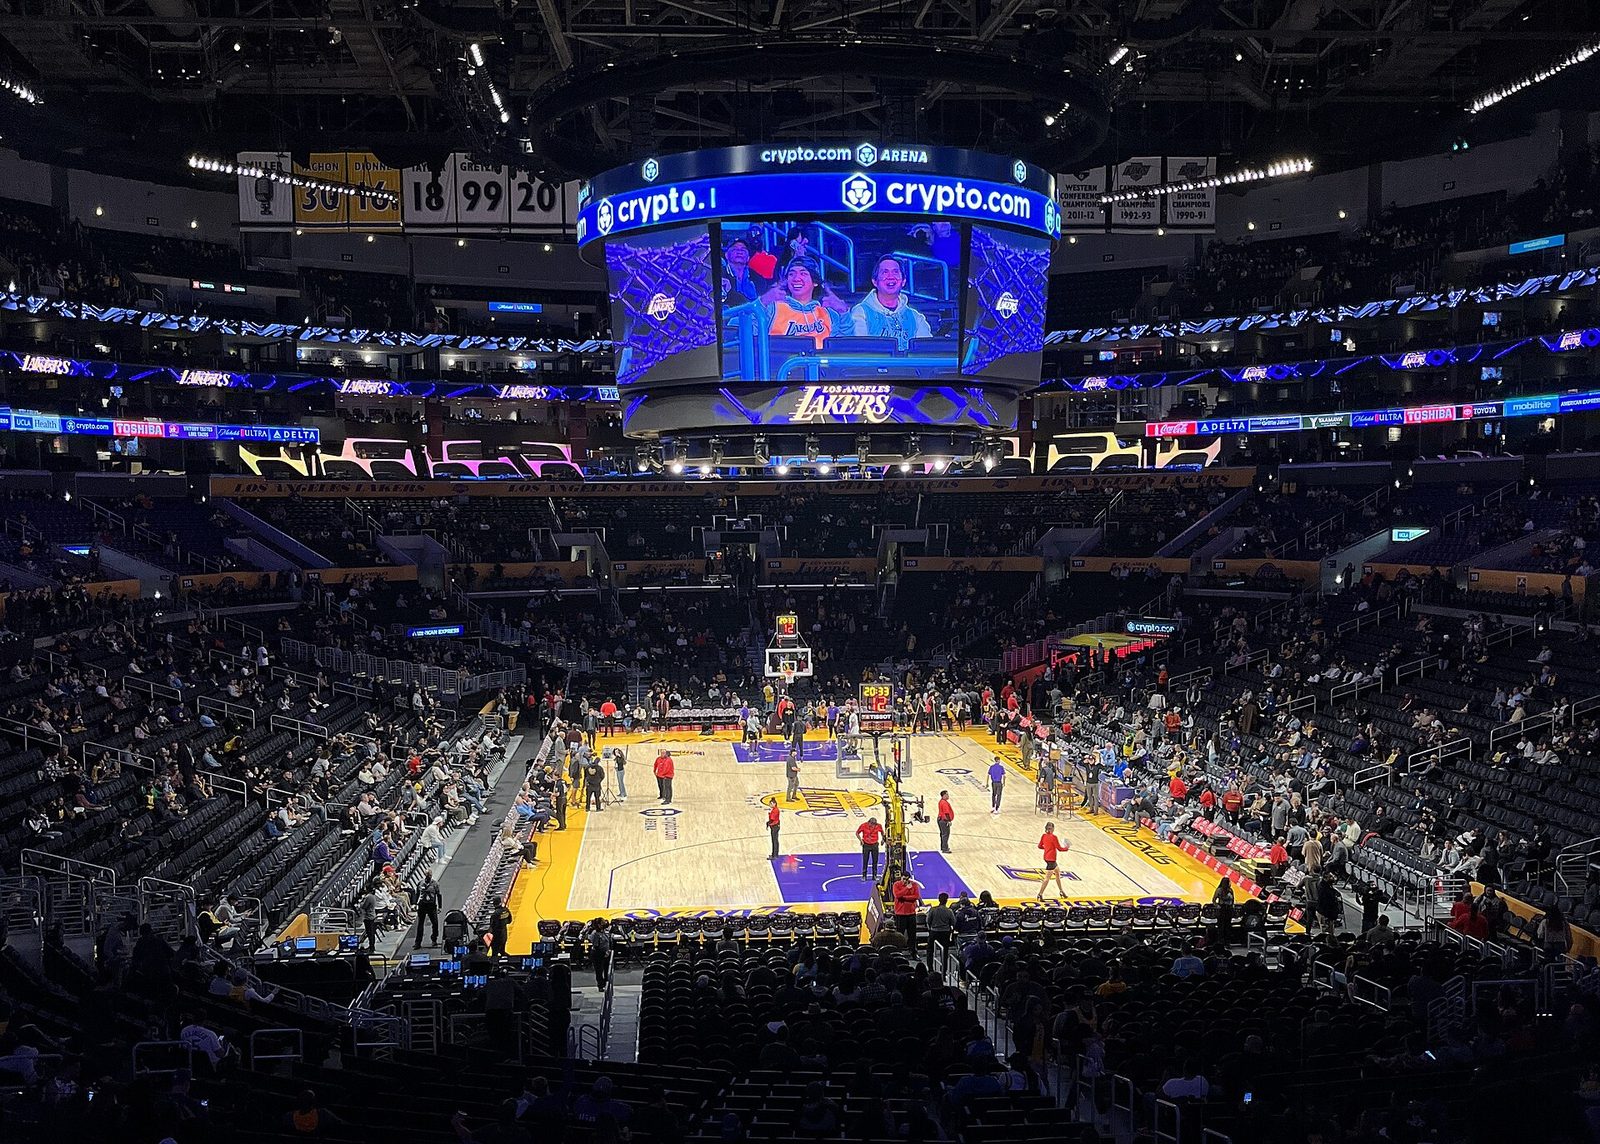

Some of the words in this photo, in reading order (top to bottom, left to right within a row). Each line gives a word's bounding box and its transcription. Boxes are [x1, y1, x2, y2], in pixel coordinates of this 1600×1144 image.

[760, 147, 851, 163] crypto.com
[881, 150, 928, 163] ARENA
[303, 163, 339, 171] ACHON
[302, 184, 339, 212] 30
[413, 181, 444, 211] 18
[462, 181, 503, 211] 99
[517, 182, 556, 211] 20
[886, 181, 1030, 219] crypto.com
[1172, 200, 1210, 208] CHAMPIONS
[1067, 211, 1095, 219] 2011-12
[1120, 211, 1151, 220] 1992-93
[1176, 211, 1206, 219] 1990-91
[822, 385, 841, 393] LOS
[843, 385, 891, 393] ANGELES
[789, 385, 894, 423] LAKERS
[1512, 400, 1551, 411] mobilitie
[1406, 407, 1453, 421] TOSHIBA
[1473, 406, 1497, 415] TOYOTA
[1379, 412, 1403, 422] ULTRA
[16, 418, 32, 427] UCLA
[34, 419, 57, 429] Health
[75, 422, 109, 432] crypto.com
[1211, 421, 1246, 431] DELTA
[116, 423, 163, 436] TOSHIBA
[245, 428, 268, 438] ULTRA
[283, 430, 316, 439] DELTA
[783, 623, 794, 634] 12
[863, 686, 890, 697] 20:33
[872, 697, 887, 712] 12
[1121, 834, 1178, 865] LEXUS
